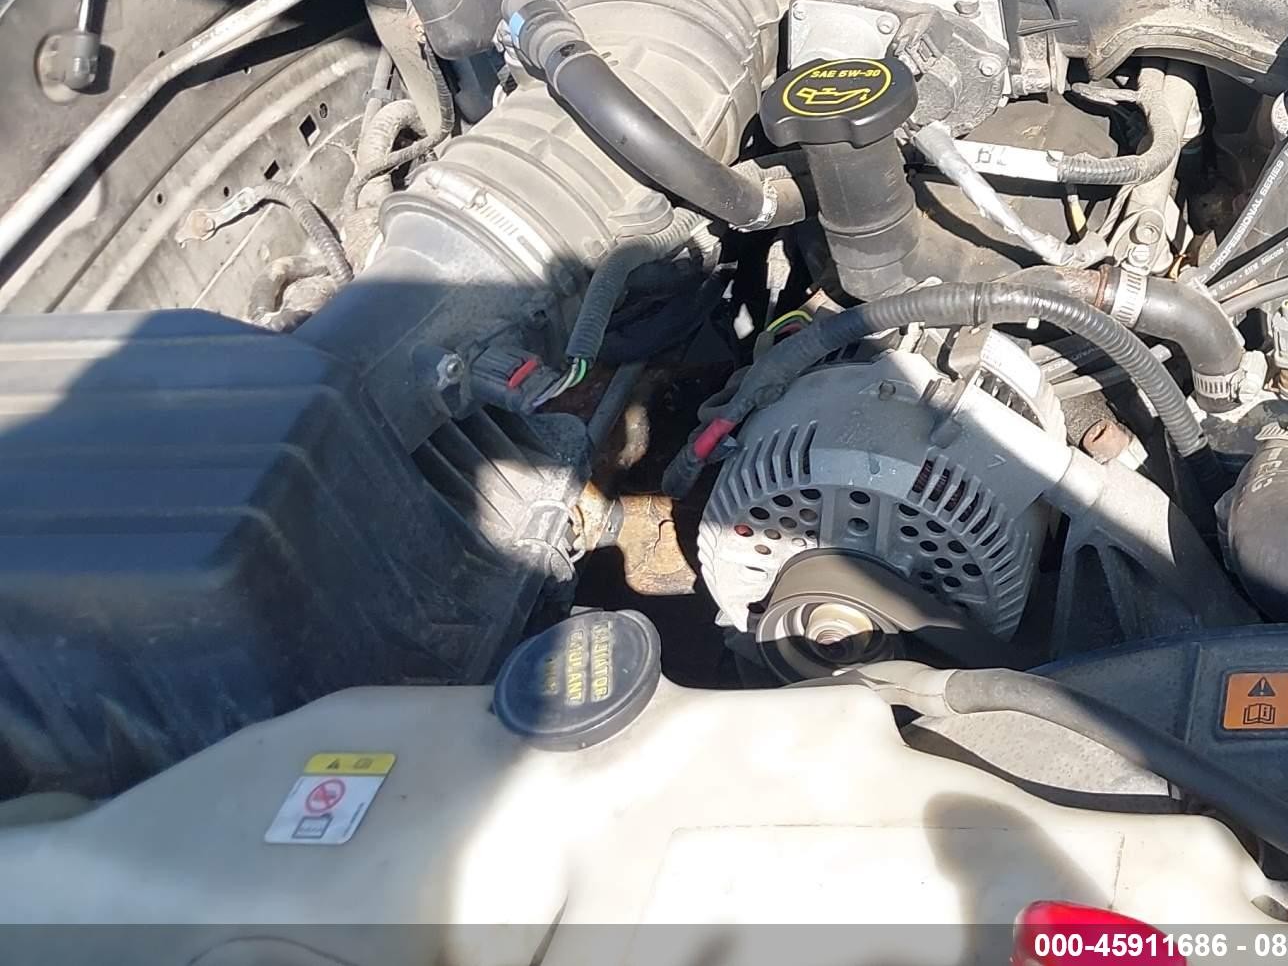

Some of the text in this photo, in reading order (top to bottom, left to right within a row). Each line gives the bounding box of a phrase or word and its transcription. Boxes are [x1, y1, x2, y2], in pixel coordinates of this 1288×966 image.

[810, 69, 881, 78] SAE 5W-30
[1209, 197, 1263, 272] PROFESSIONAL
[1260, 159, 1285, 197] SERIES
